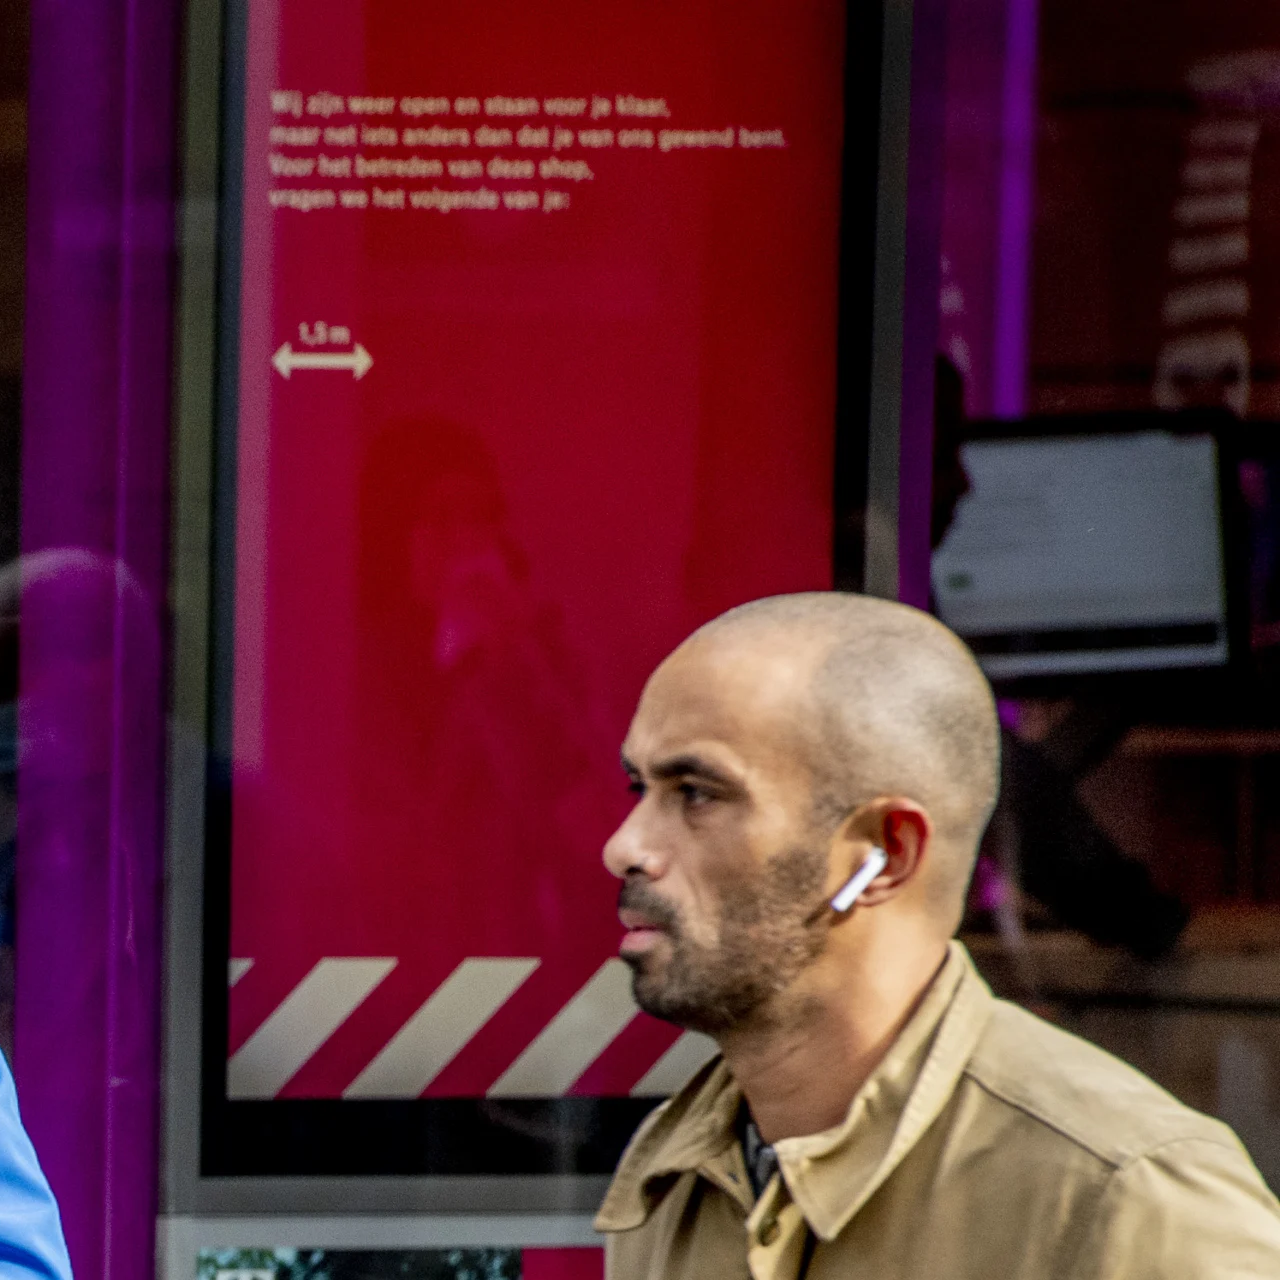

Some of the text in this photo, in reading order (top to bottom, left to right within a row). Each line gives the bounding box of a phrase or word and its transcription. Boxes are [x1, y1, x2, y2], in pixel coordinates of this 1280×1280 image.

[348, 96, 395, 115] weer
[400, 96, 450, 117] open
[454, 97, 480, 115] en
[544, 97, 587, 116] voor
[591, 97, 611, 119] je
[474, 125, 512, 147] dan
[553, 128, 574, 150] je
[578, 128, 614, 149] van
[317, 154, 352, 178] het
[448, 159, 483, 179] van
[339, 189, 368, 209] we
[503, 190, 539, 211] van
